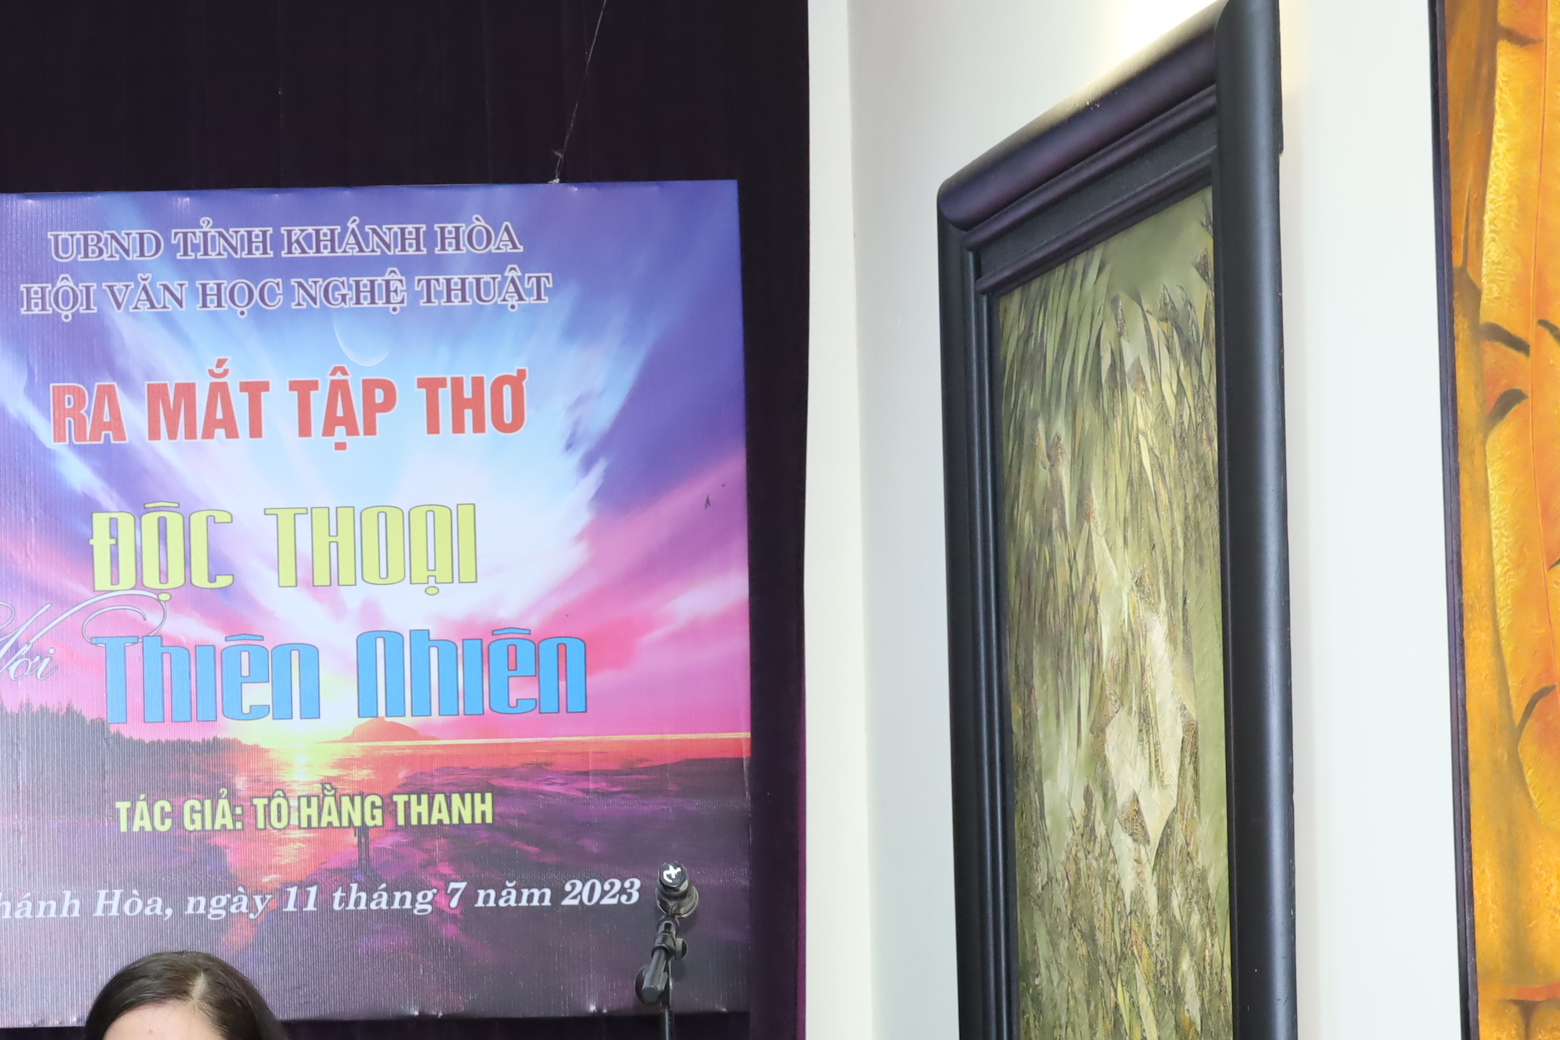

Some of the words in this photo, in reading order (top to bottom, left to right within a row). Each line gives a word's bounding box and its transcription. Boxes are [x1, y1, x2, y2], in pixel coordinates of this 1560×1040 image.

[48, 230, 164, 262] UBND
[171, 217, 274, 259] TỈNH
[281, 216, 426, 257] KHÁNH
[434, 214, 524, 255] HÒA
[20, 274, 98, 322] HỘI
[102, 273, 189, 313] VĂN
[196, 278, 284, 318] HỌC
[291, 267, 407, 314] NGHỆ
[414, 264, 553, 312] THUẬT
[49, 381, 129, 445] RA
[144, 357, 271, 443] MẮT
[287, 364, 398, 452] TẬP
[415, 366, 529, 436] THƠ
[88, 500, 235, 602] ĐỘC
[263, 503, 478, 596] THOẠI
[90, 633, 321, 724] Thiên
[355, 626, 588, 719] Nhiên
[114, 794, 172, 832] TÁC
[182, 788, 243, 831] GIẢ:
[252, 790, 290, 830] TÔ
[298, 784, 384, 828] HẰNG
[392, 792, 494, 825] THANH
[92, 888, 174, 921] Hòa,
[183, 886, 272, 921] ngày
[282, 885, 319, 912] 11
[332, 883, 438, 916] tháng
[446, 881, 468, 909] 7
[474, 880, 553, 908] năm
[560, 877, 642, 907] 2023
